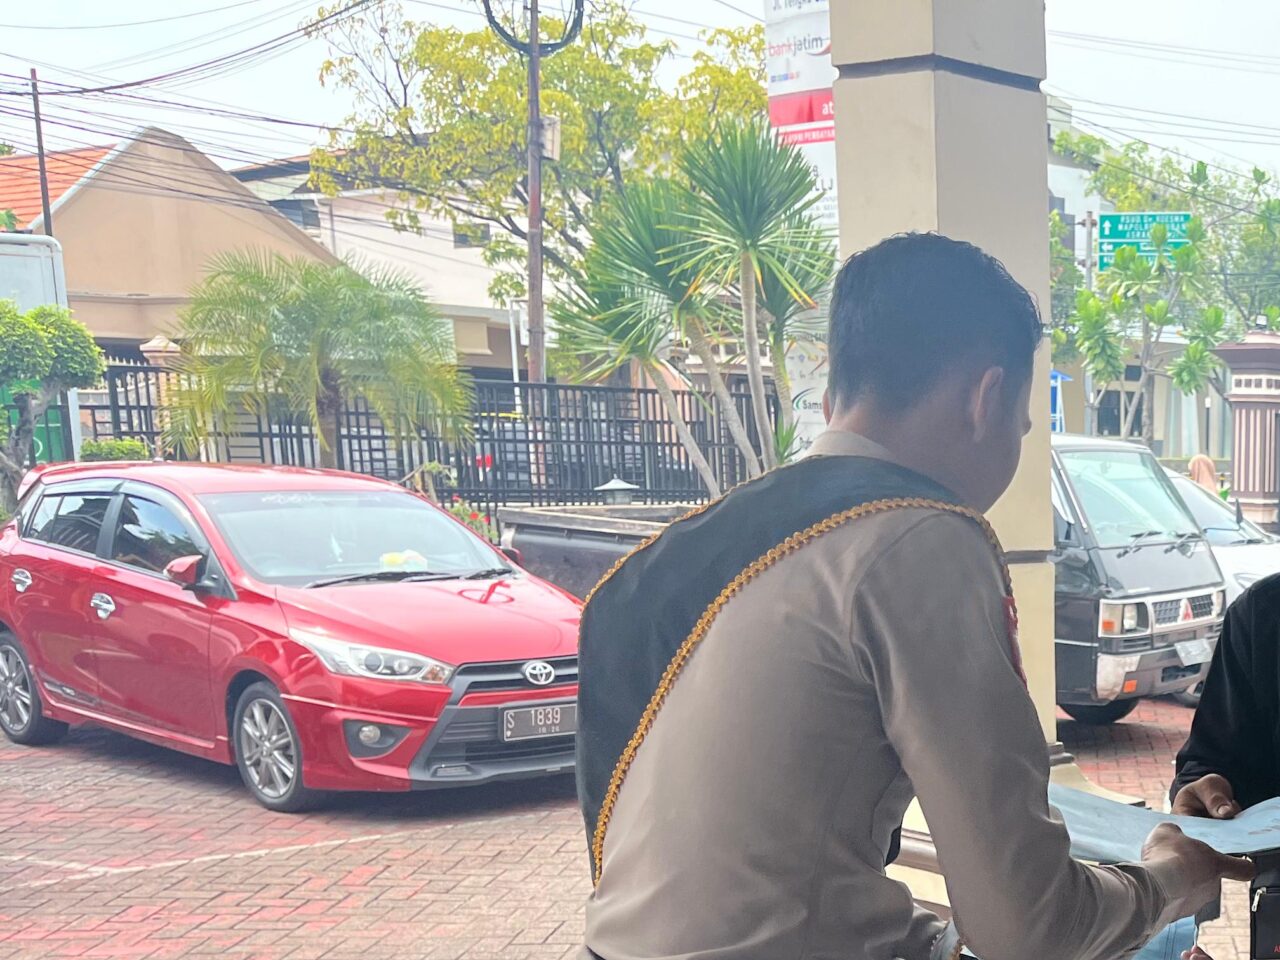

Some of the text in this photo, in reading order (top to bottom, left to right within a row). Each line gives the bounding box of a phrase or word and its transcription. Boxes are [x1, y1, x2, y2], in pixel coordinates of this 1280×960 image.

[768, 34, 822, 56] bankjatim
[507, 707, 560, 728] S 1839
